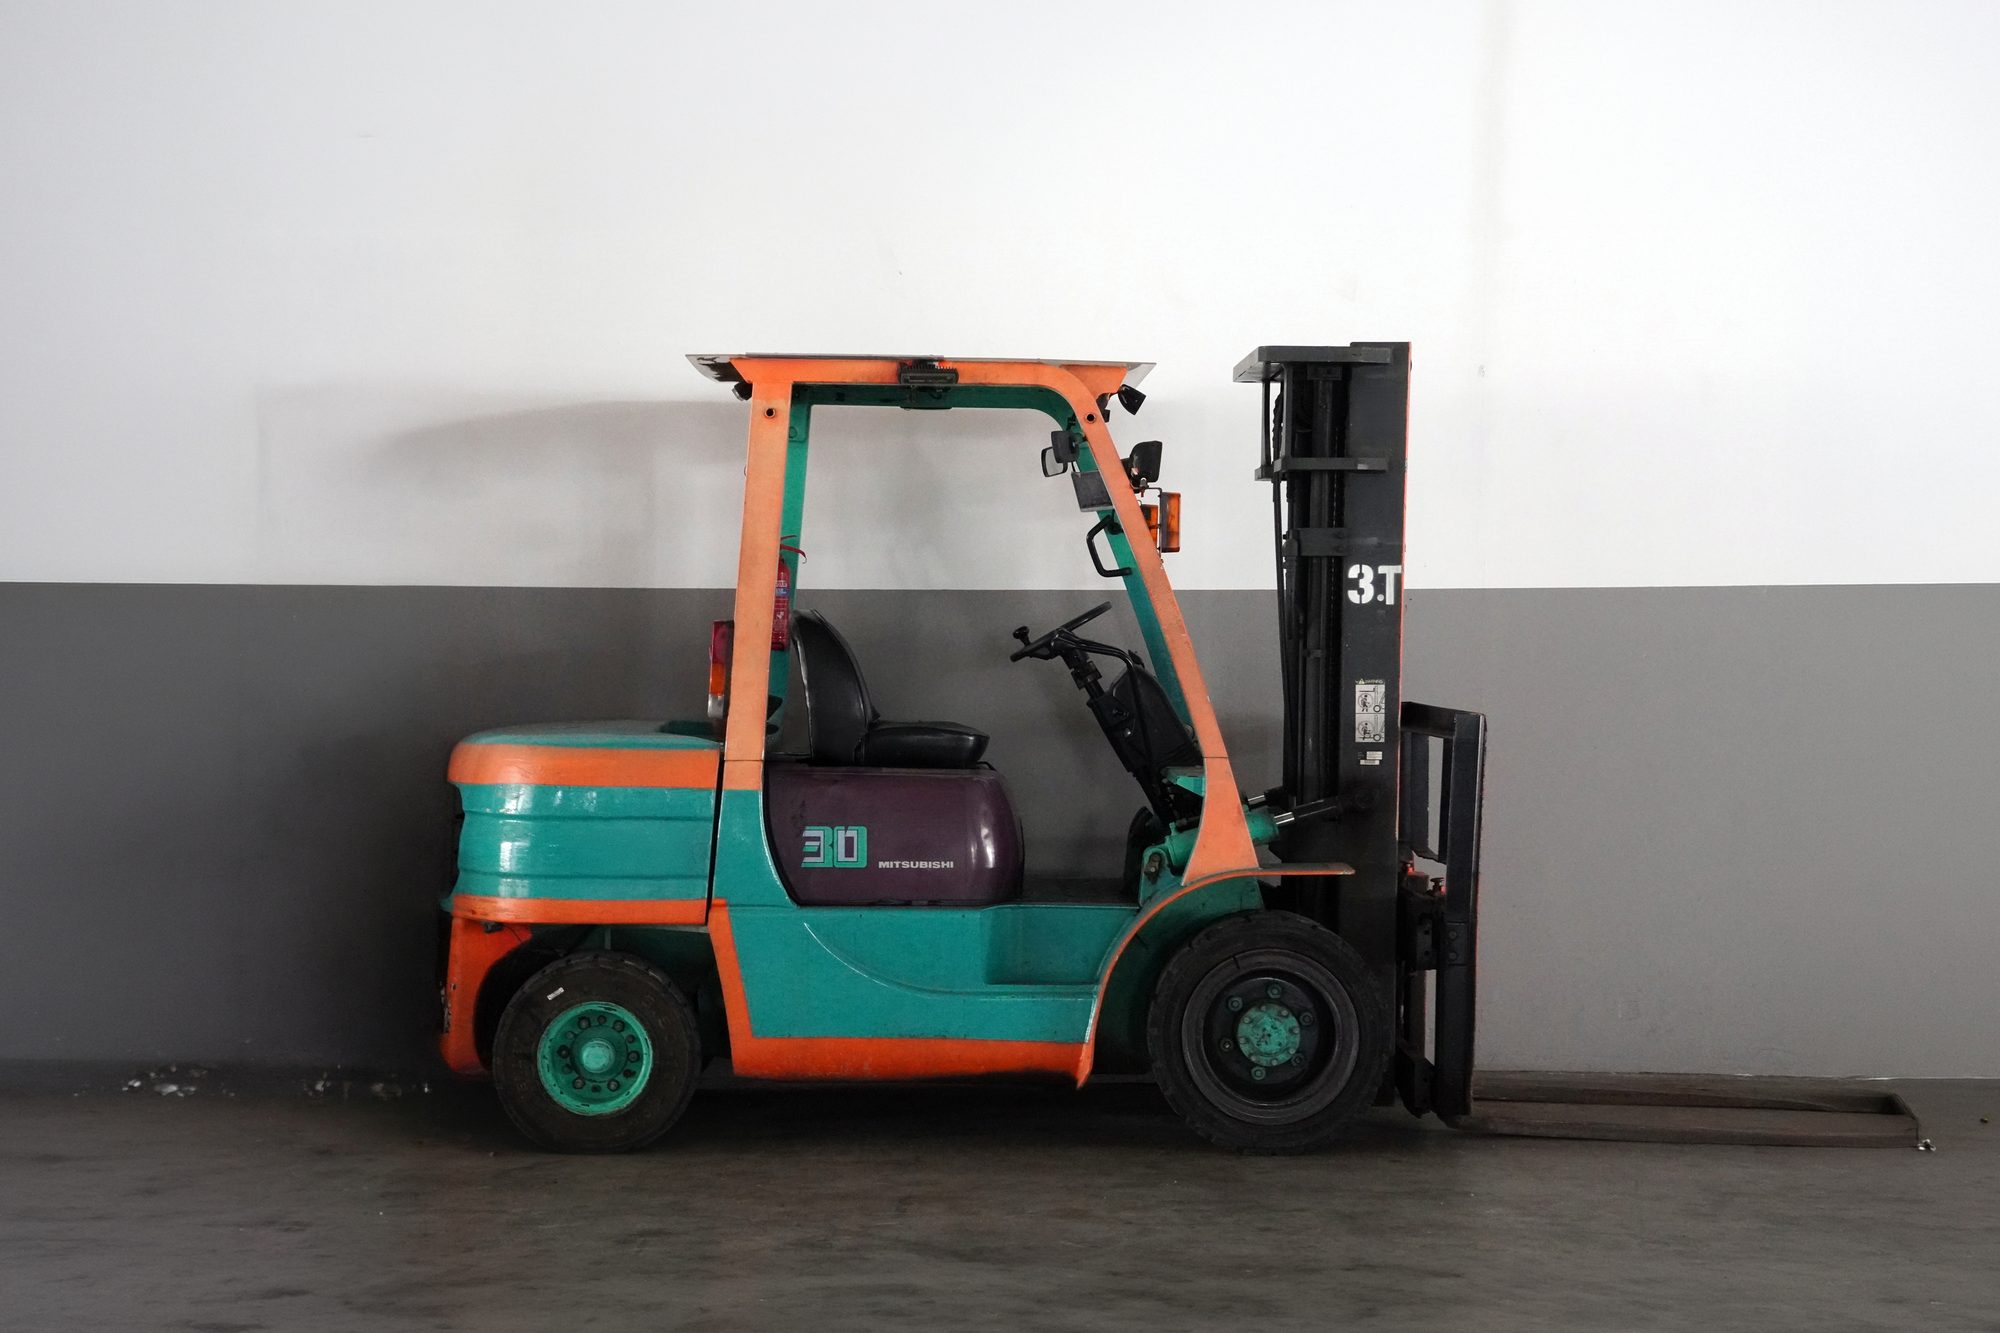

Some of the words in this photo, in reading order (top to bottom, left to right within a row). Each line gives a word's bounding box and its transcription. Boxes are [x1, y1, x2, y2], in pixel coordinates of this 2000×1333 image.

[1347, 564, 1402, 605] 3.T
[801, 826, 867, 868] 30
[878, 860, 954, 869] MITSUBISHI
